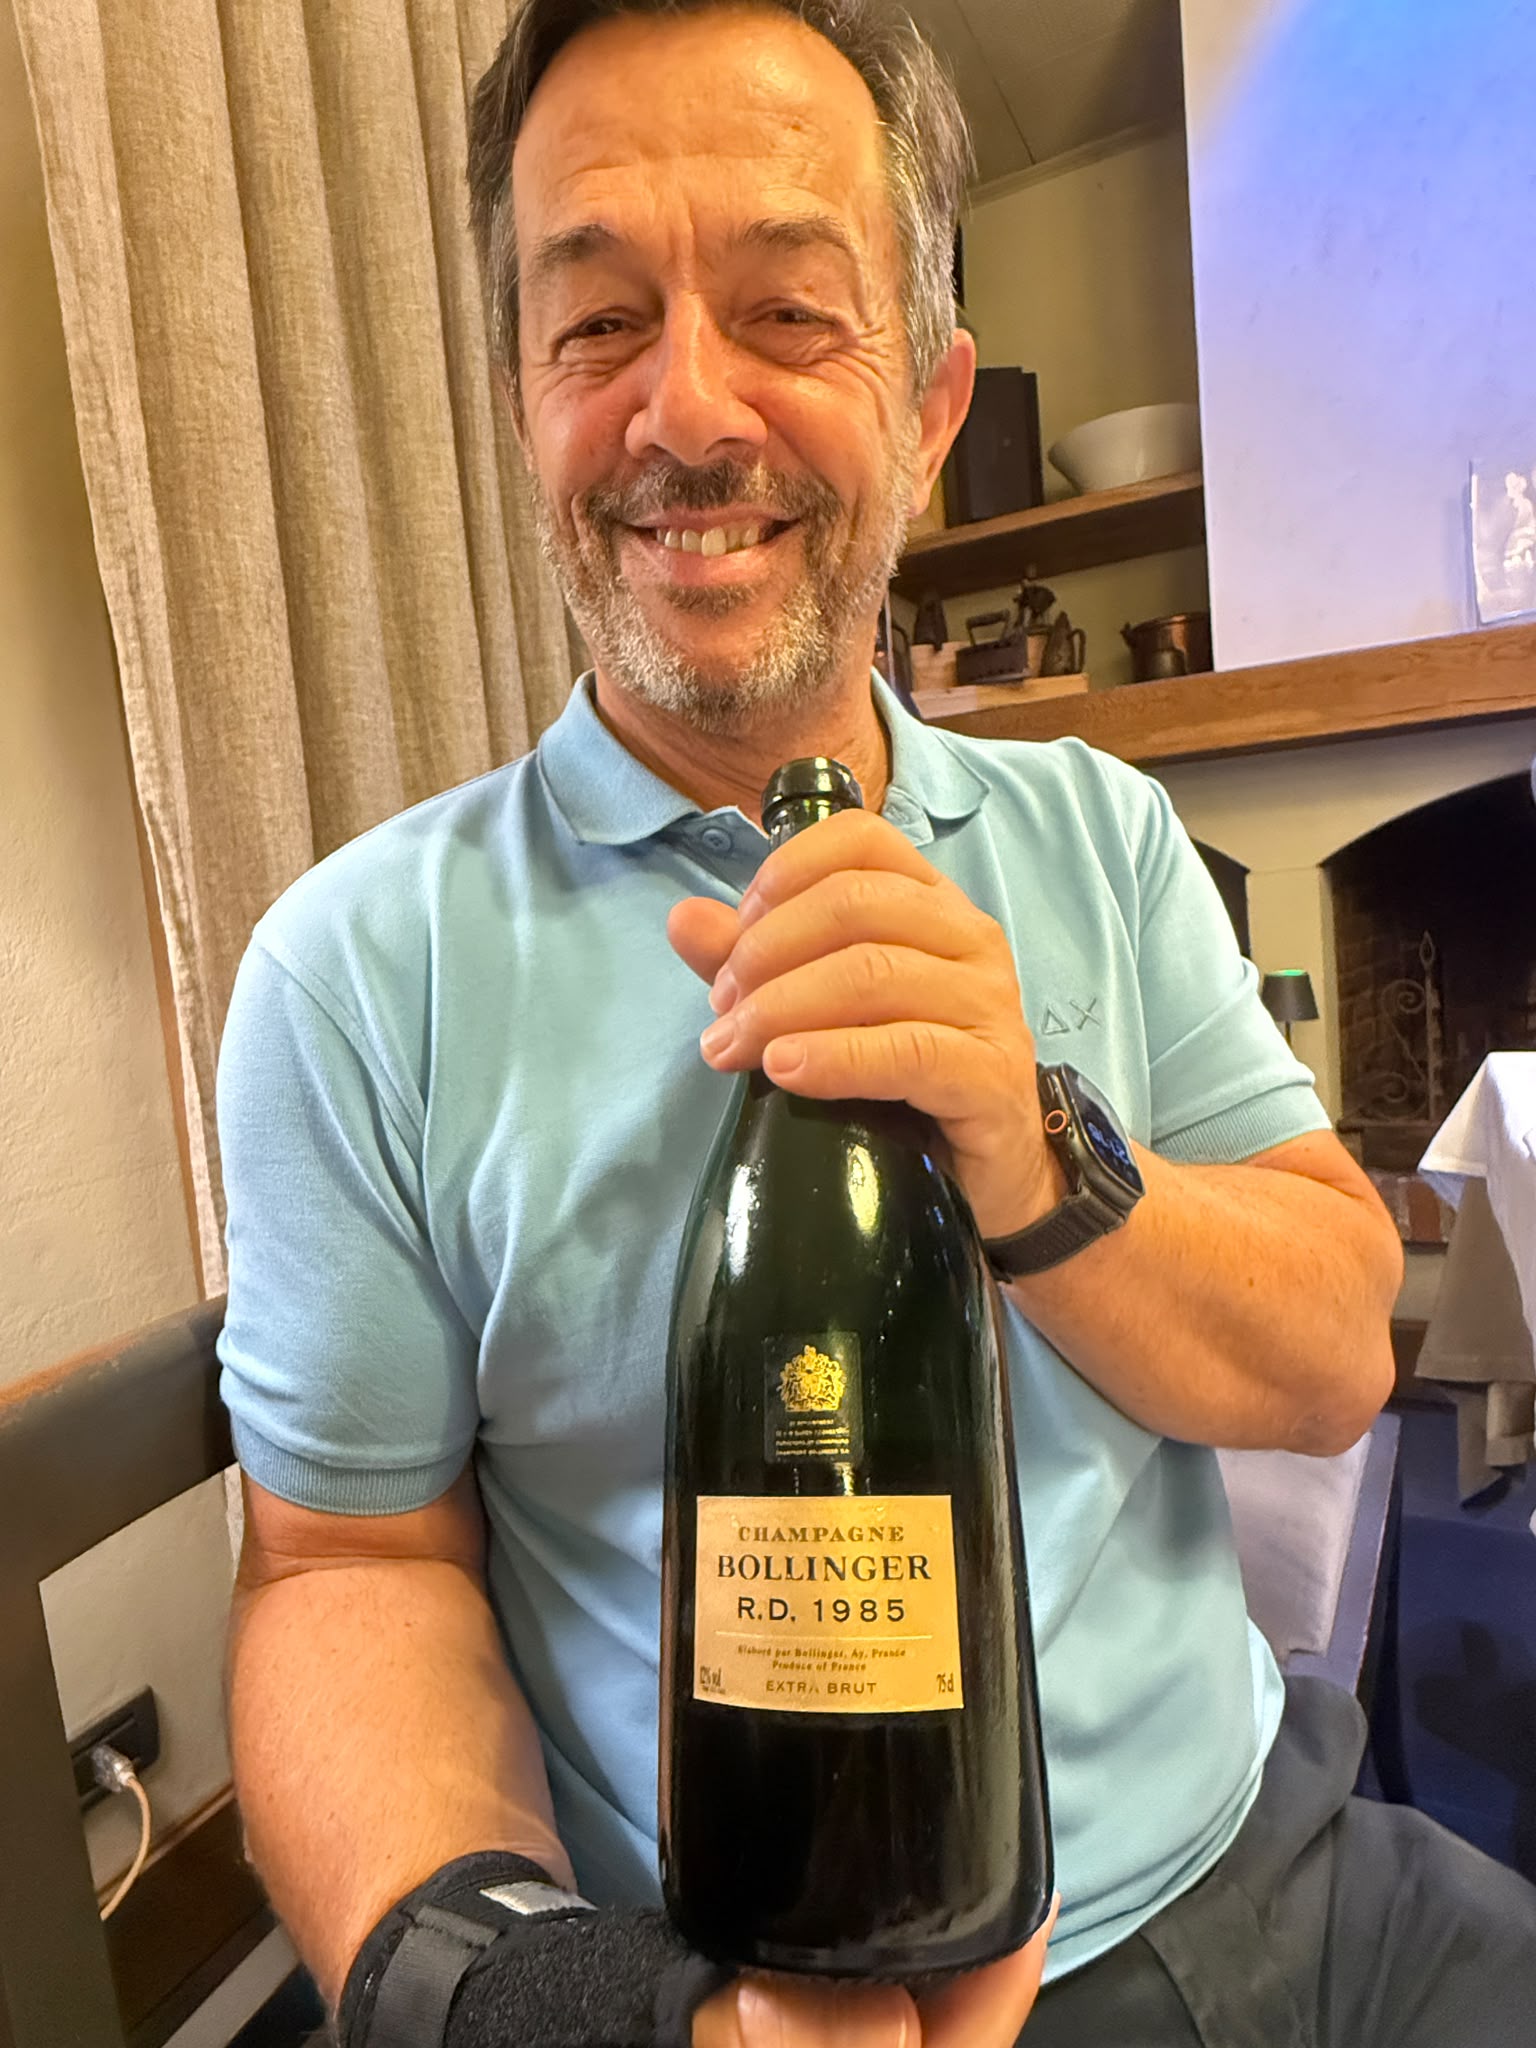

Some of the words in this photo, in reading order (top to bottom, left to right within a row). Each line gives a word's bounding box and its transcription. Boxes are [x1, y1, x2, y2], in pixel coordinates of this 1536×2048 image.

[738, 1526, 904, 1542] CHAMPAGNE
[718, 1554, 932, 1581] BOLLINGER
[737, 1596, 796, 1622] R.D.
[813, 1598, 905, 1622] 1985
[772, 1660, 812, 1671] Produce
[816, 1661, 827, 1671] of
[831, 1661, 867, 1671] France
[766, 1680, 819, 1693] EXTRA
[827, 1682, 877, 1694] BRUT
